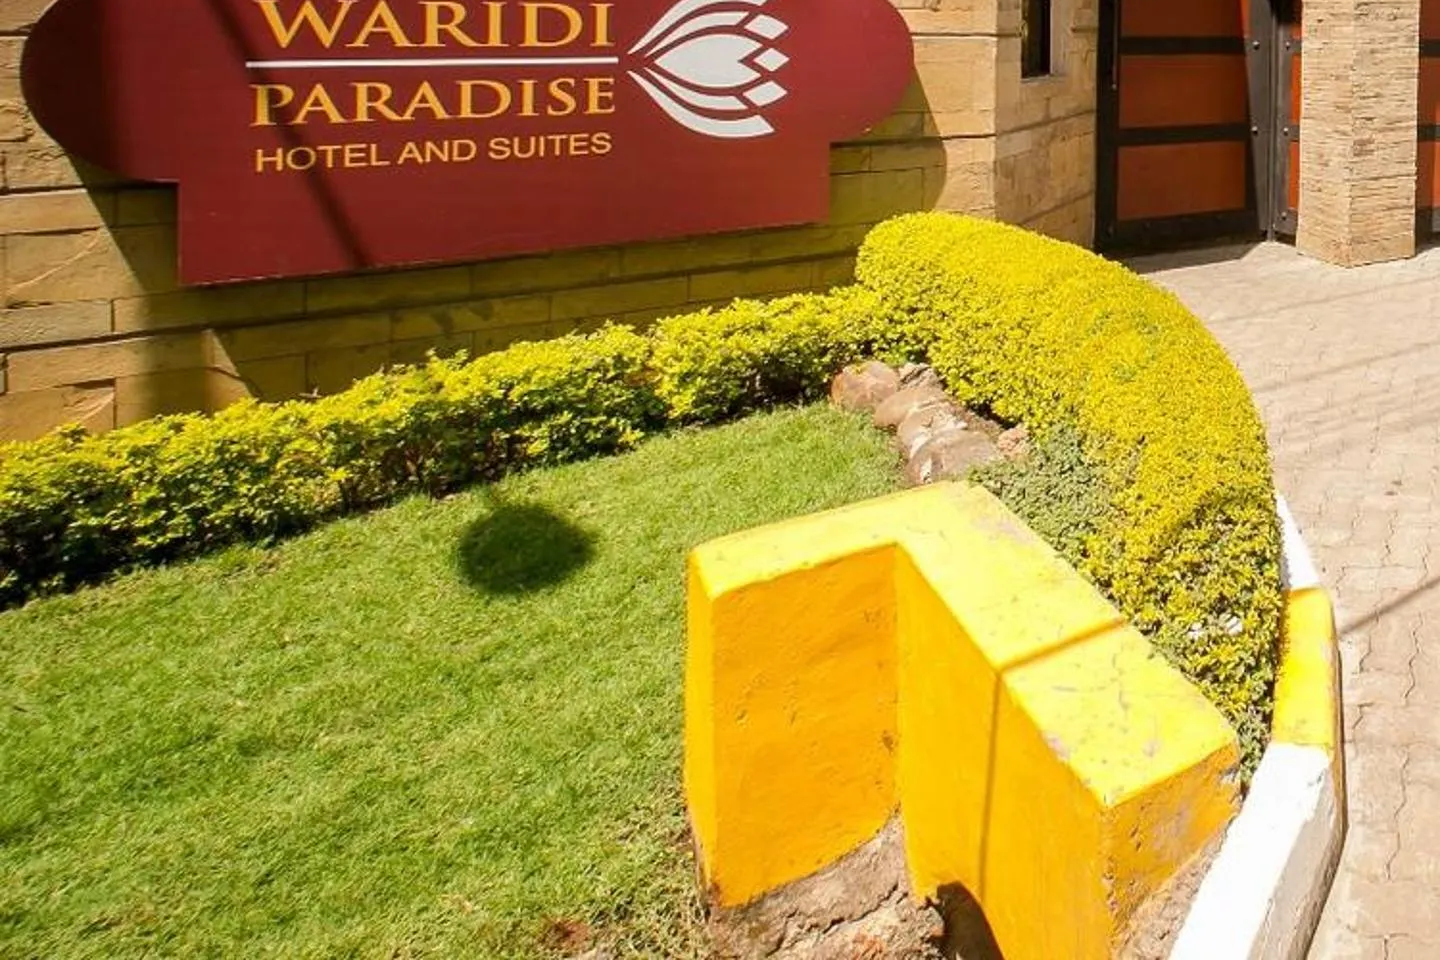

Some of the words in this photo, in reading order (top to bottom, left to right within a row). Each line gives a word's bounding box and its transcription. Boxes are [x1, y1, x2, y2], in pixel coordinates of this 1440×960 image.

[250, 76, 617, 126] PARADISE
[254, 143, 391, 173] HOTEL
[397, 139, 478, 165] AND
[488, 131, 613, 160] SUITES
